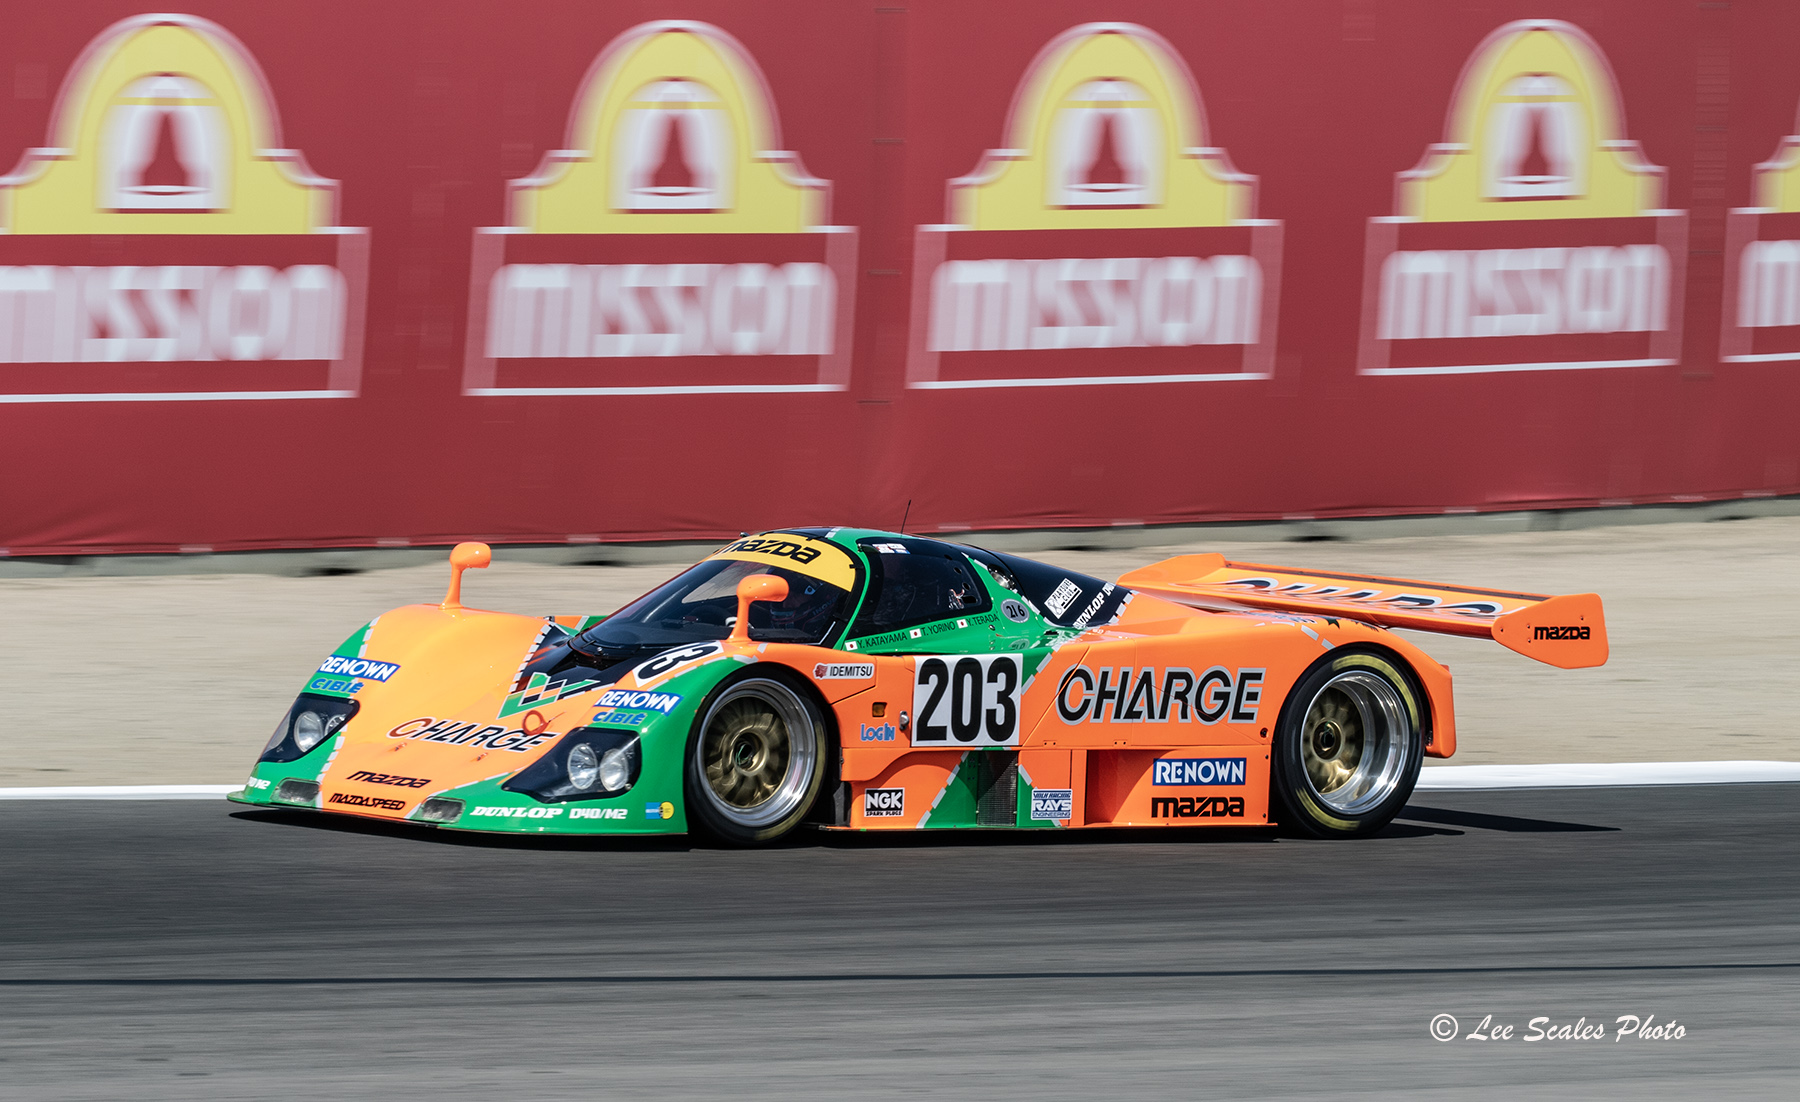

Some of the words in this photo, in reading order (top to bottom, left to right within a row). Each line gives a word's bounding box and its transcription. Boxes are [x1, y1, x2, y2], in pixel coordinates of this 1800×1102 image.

[928, 255, 1264, 352] MSSON
[1376, 243, 1671, 340] MSSON
[0, 264, 348, 363] MSSON
[484, 262, 838, 358] MSSON
[1005, 604, 1026, 618] 216
[866, 632, 908, 648] KATAYAMA
[928, 621, 956, 635] YORINO
[320, 656, 398, 681] RENOWN
[829, 665, 873, 677] IDEMITSU
[594, 690, 681, 714] RENOWN
[915, 656, 1019, 743] 203
[1056, 664, 1267, 726] CHARGE
[386, 716, 562, 754] CHARGE
[1154, 760, 1245, 784] RENOWN
[328, 793, 406, 811] MAZDASPEED
[866, 791, 902, 809] NGK
[1032, 799, 1072, 811] RAYS
[469, 806, 564, 819] DUNLOP
[569, 808, 629, 819] D40/M2
